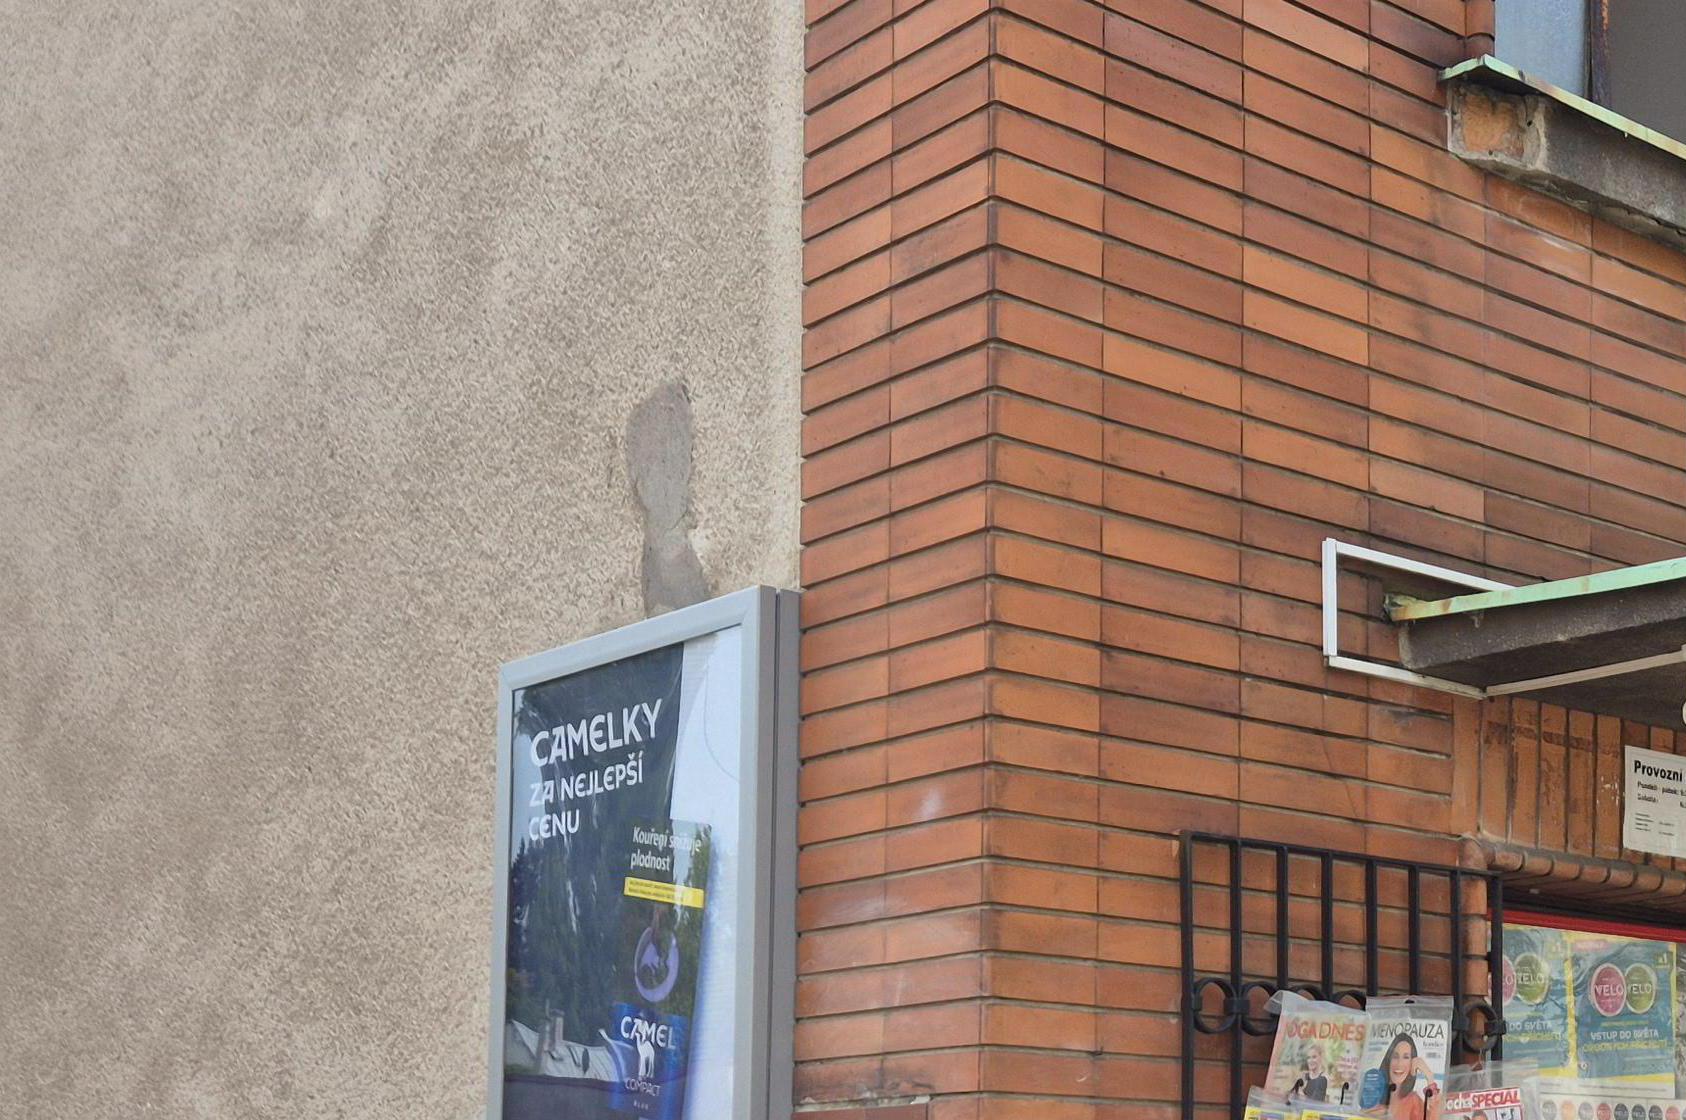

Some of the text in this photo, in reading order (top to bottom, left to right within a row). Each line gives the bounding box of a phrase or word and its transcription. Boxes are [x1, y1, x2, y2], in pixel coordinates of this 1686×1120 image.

[529, 698, 663, 767] CAMELKY
[528, 750, 645, 808] ZA NEJLEPŠÍ
[527, 808, 581, 841] CENU
[630, 849, 670, 872] plodnost
[620, 1015, 677, 1050] CAMEL
[1371, 1022, 1444, 1039] MENOPAUZA
[1591, 1030, 1618, 1041] VSTUP
[624, 1077, 662, 1098] COMPACT
